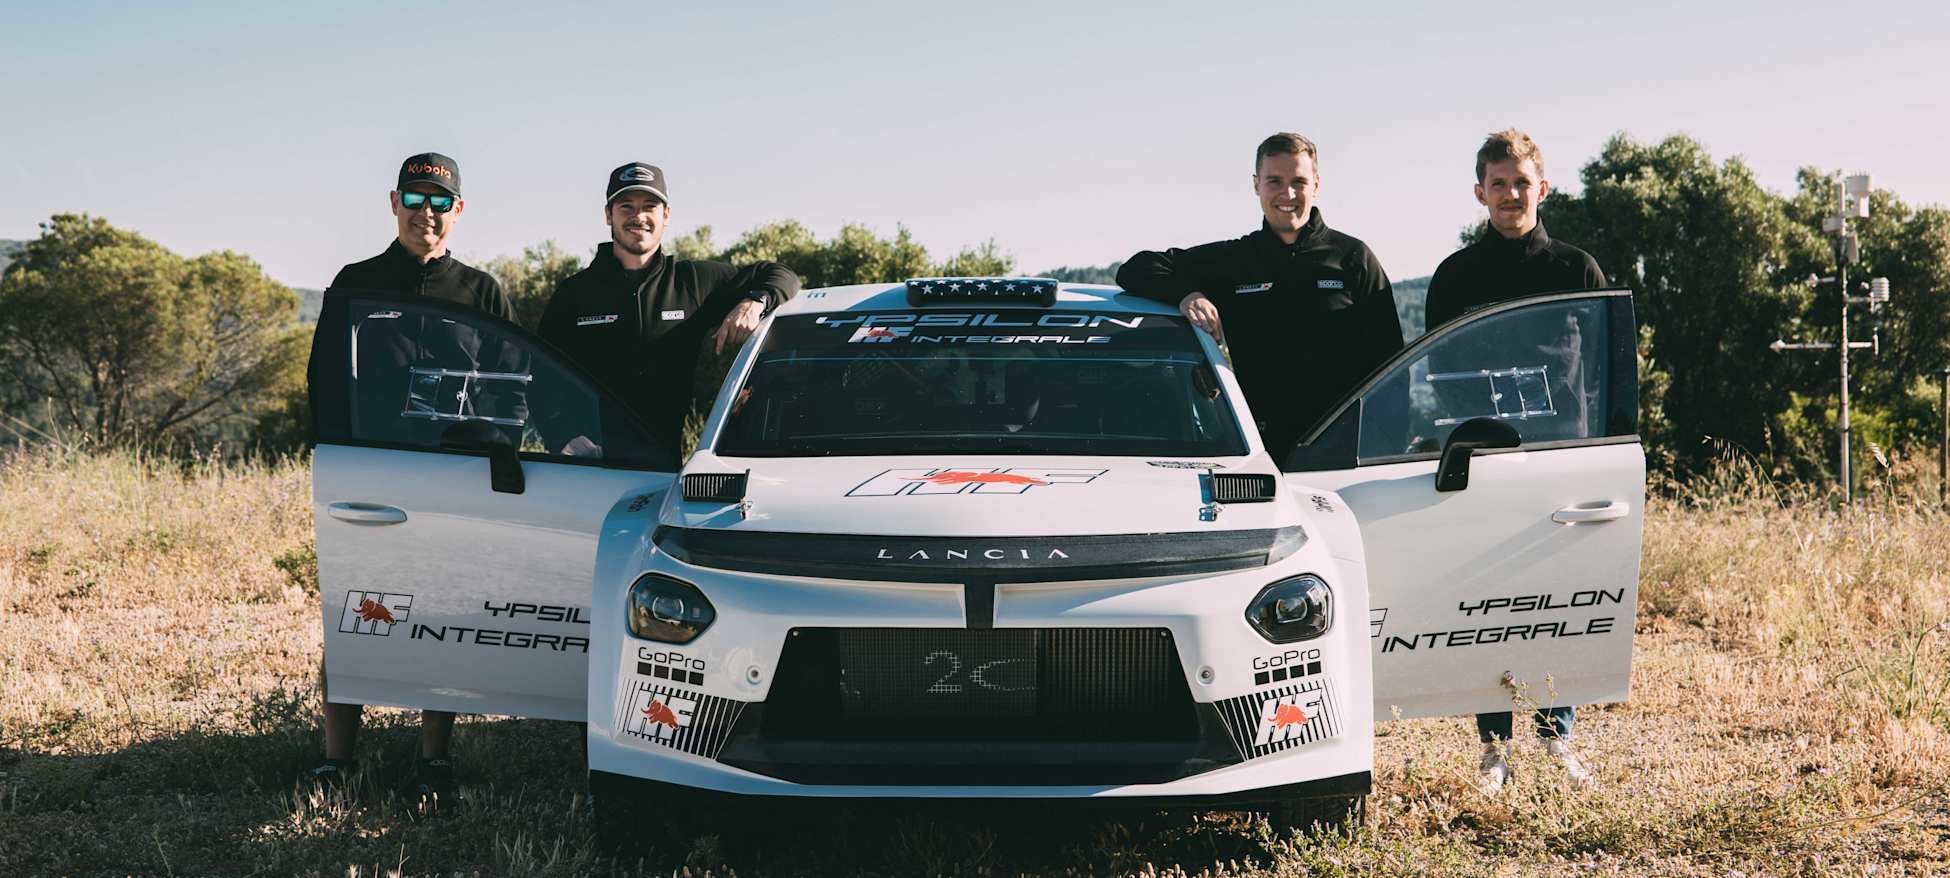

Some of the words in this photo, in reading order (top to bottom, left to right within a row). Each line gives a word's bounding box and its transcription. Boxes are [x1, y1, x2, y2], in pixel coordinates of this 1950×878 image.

[408, 162, 452, 179] Kubota
[816, 314, 1144, 328] YPSILON
[877, 549, 1069, 560] LANCIA
[1459, 588, 1624, 616] YPSILON
[1382, 617, 1615, 653] INTEGRALE
[638, 646, 705, 671] GoPro
[1253, 648, 1321, 670] GoPro
